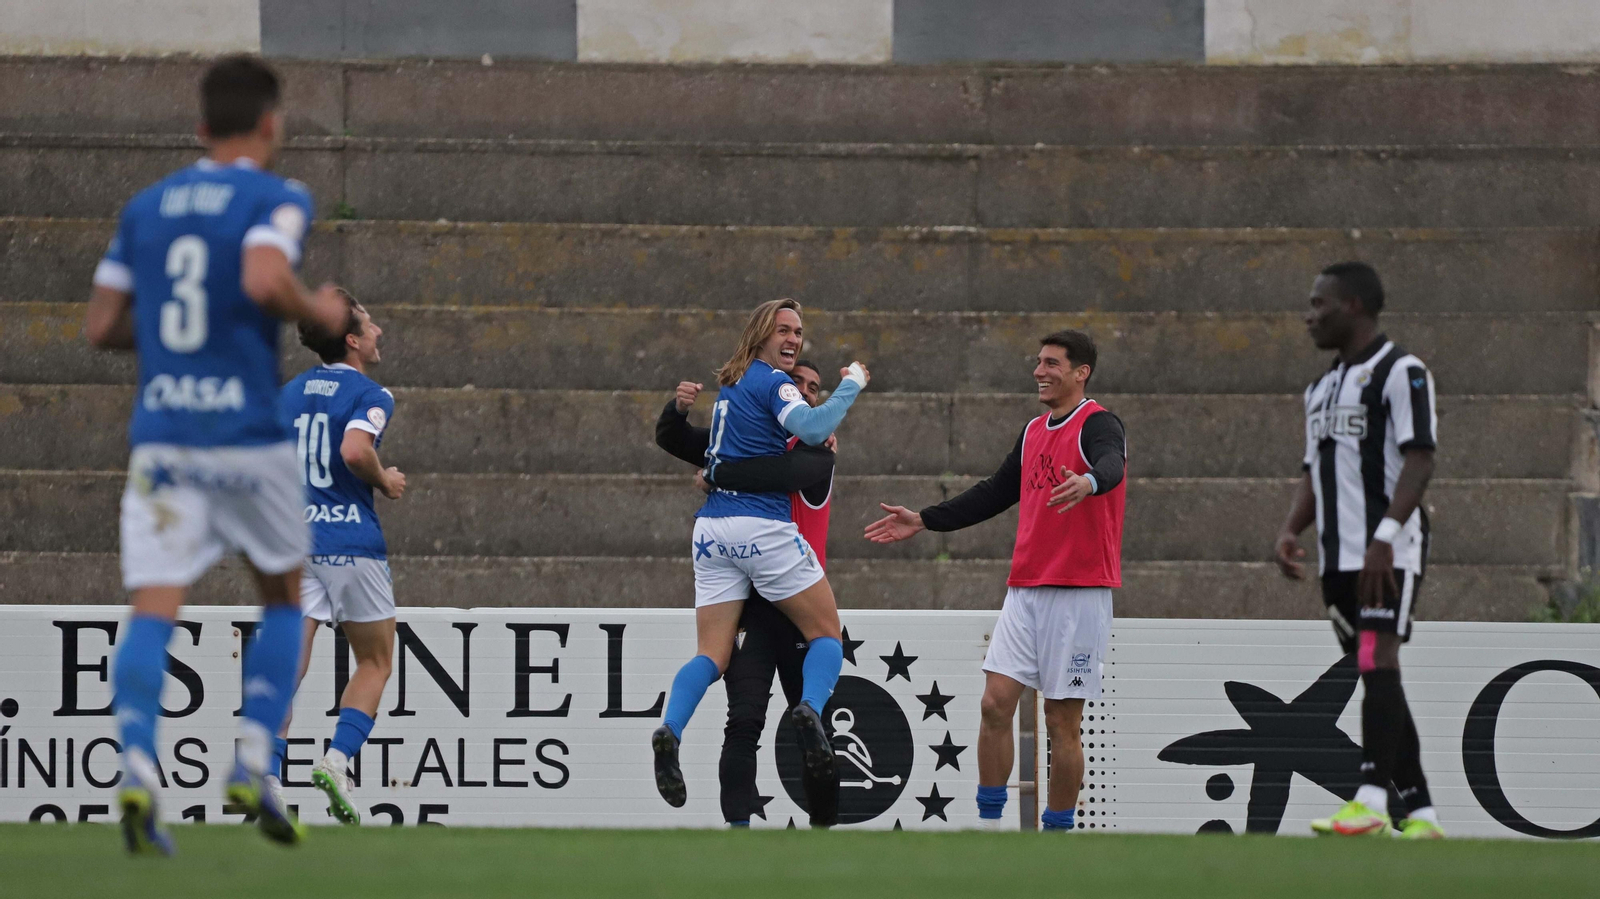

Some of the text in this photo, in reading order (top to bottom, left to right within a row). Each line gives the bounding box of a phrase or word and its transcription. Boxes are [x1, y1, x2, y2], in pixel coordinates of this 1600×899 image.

[159, 235, 210, 354] 3
[293, 412, 333, 488] 10
[716, 543, 762, 560] PLAZA
[52, 620, 667, 718] ESINEL
